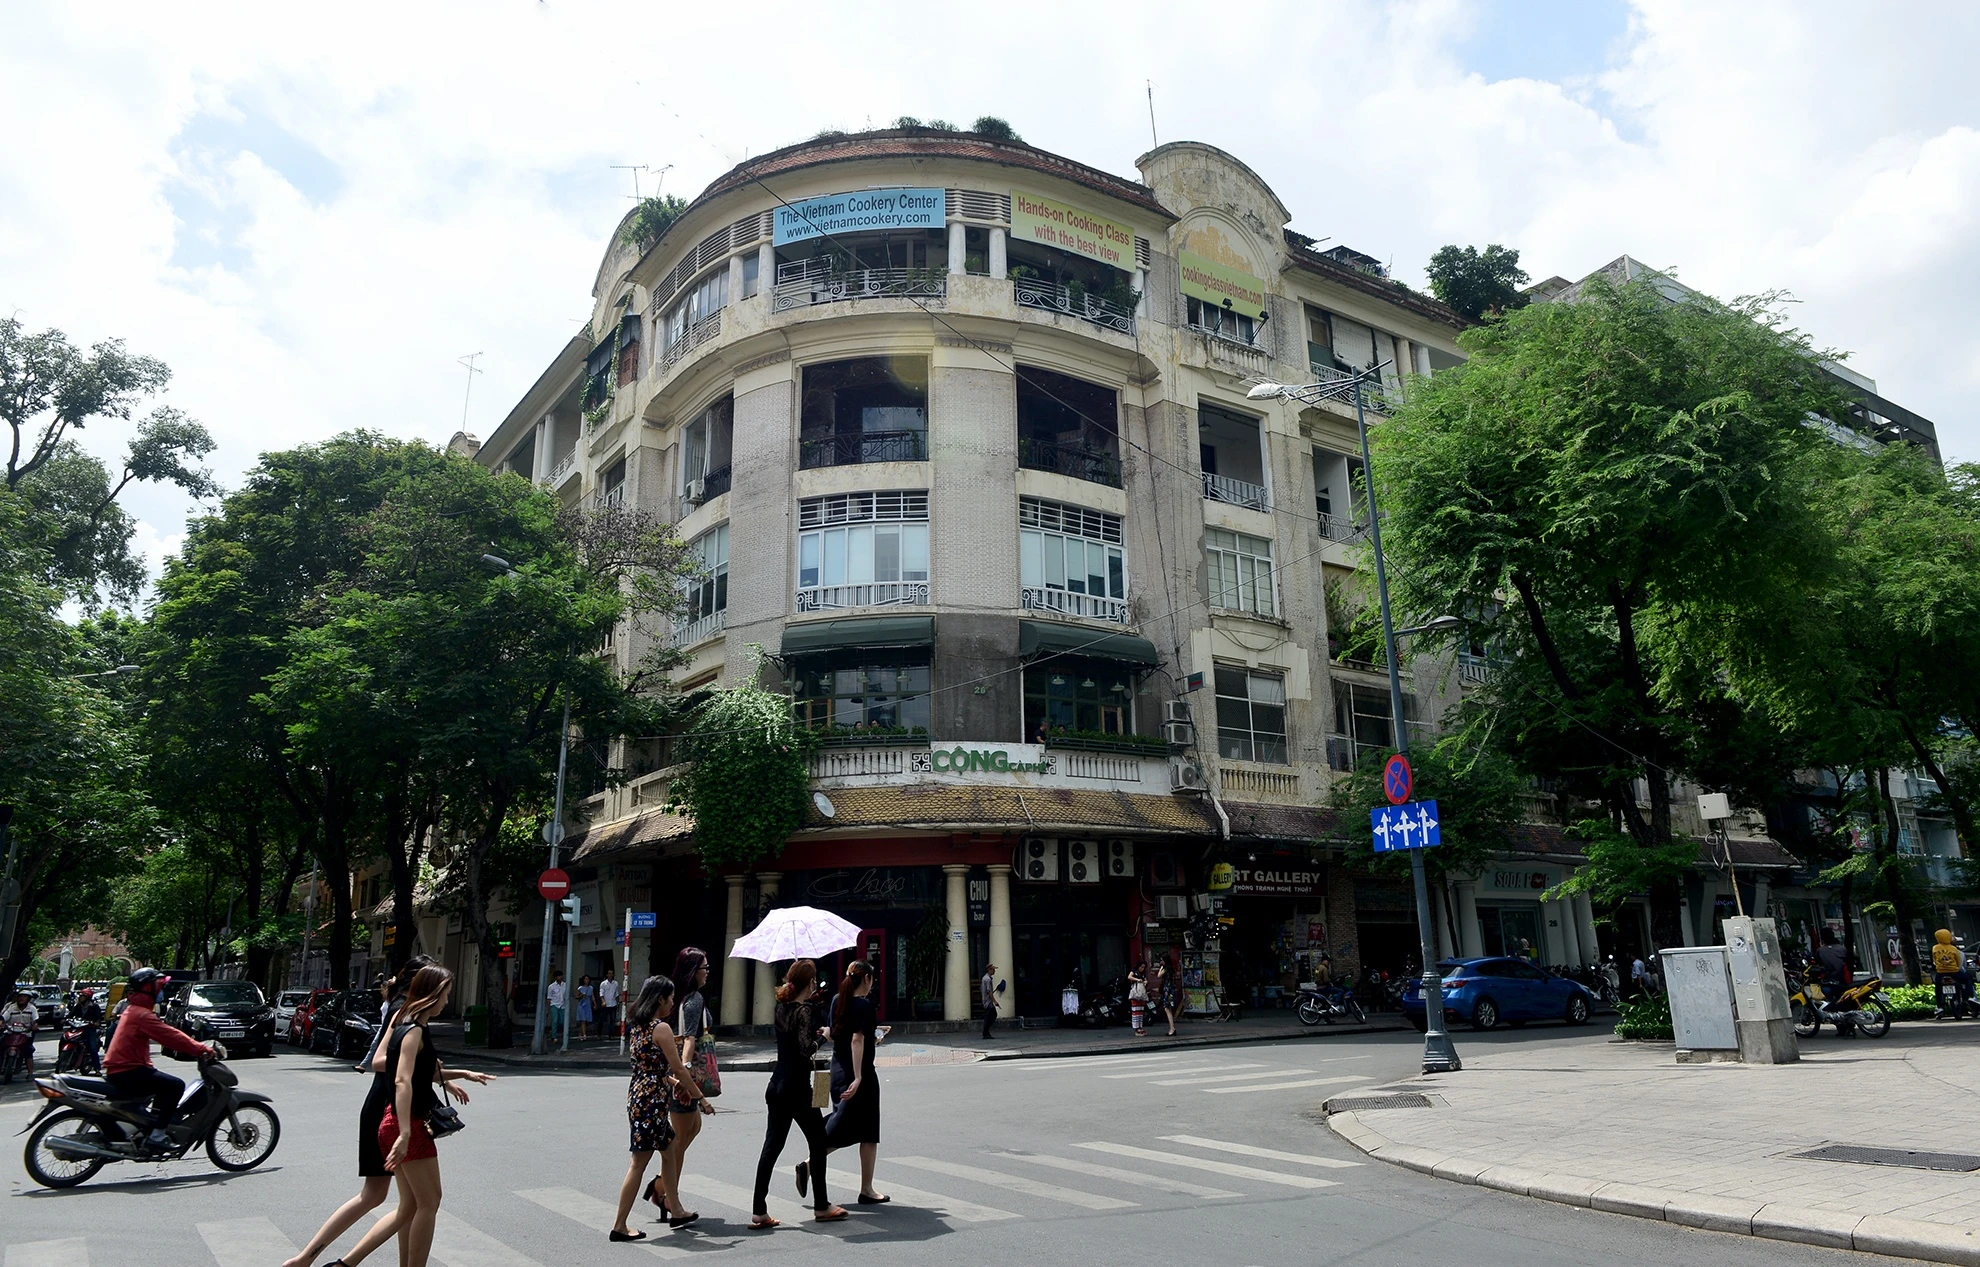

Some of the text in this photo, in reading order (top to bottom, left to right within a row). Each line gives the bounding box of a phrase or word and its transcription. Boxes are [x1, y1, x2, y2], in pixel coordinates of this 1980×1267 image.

[781, 194, 938, 226] The Vietnam Cookery Center
[1018, 196, 1130, 246] Hands-on Cooking Class
[786, 213, 931, 238] www.vietnamcookery.com
[1034, 224, 1120, 262] with the best view
[1182, 266, 1263, 307] cookingclassvietnam.com
[932, 745, 1009, 776] CỘNG
[618, 867, 648, 880] ARTSKY
[1234, 869, 1321, 884] RT GALLERY
[1495, 871, 1522, 889] SODA
[970, 880, 988, 901] CHU
[973, 911, 986, 921] bar
